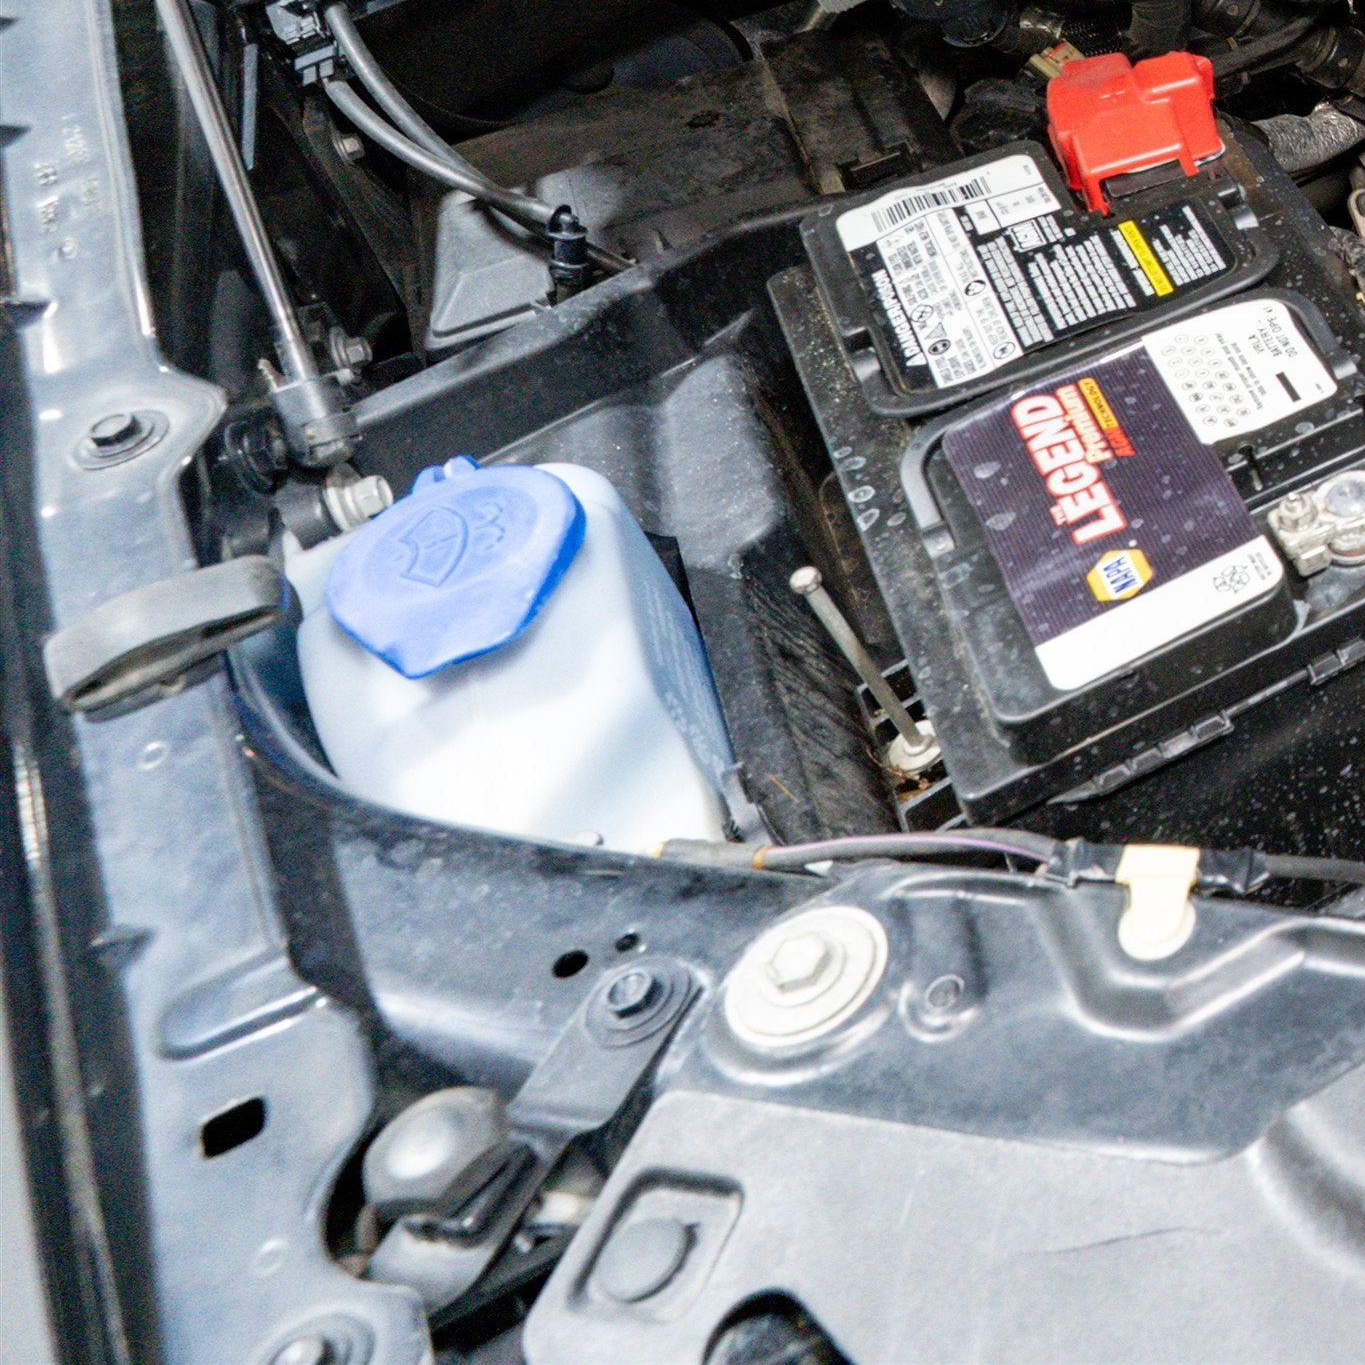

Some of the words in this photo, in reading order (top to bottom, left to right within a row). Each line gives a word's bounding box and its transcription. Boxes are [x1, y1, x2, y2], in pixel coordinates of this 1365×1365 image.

[1247, 333, 1265, 354] VRLA
[1256, 326, 1282, 357] BATTERY
[1275, 333, 1290, 347] NOT
[1284, 346, 1298, 358] DO
[1081, 378, 1115, 429] TECHNOLOGY
[1052, 381, 1114, 465] Premium
[1103, 425, 1135, 458] AGM
[1007, 392, 1129, 548] LEGEND
[1100, 555, 1139, 595] NAPA
